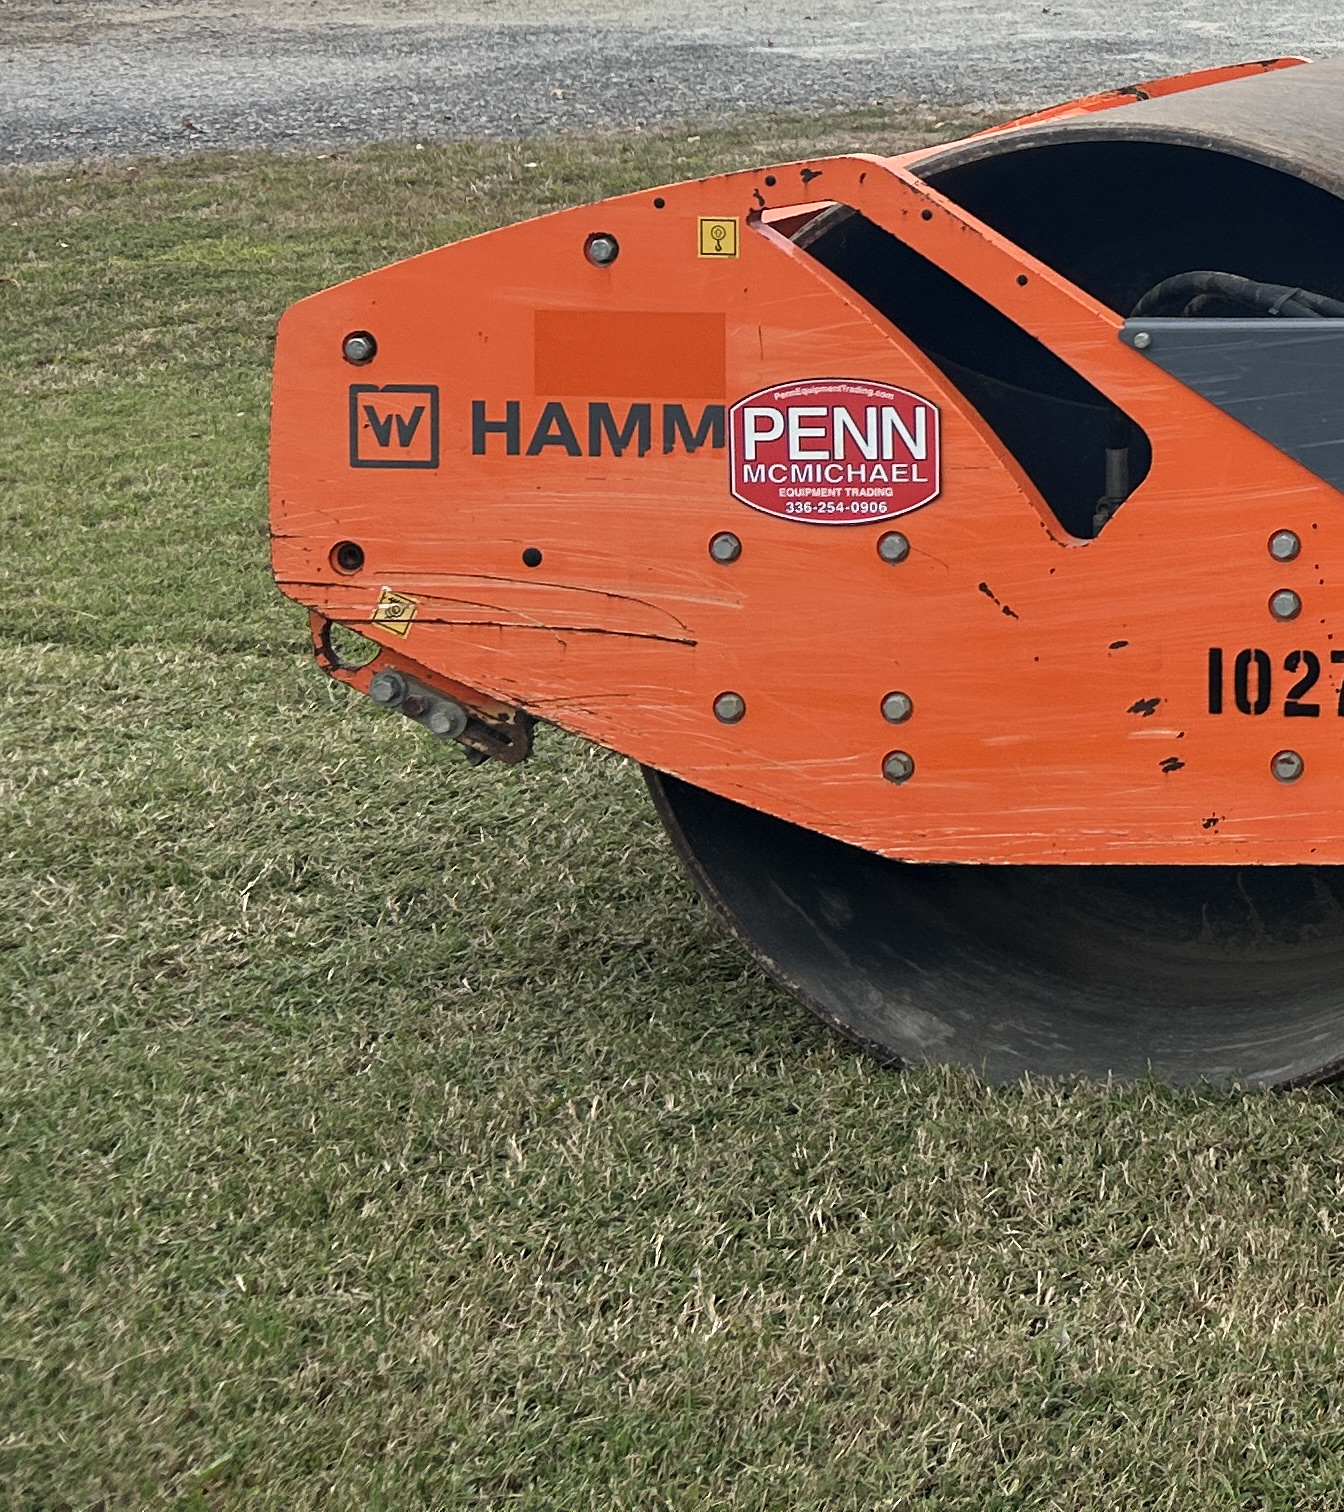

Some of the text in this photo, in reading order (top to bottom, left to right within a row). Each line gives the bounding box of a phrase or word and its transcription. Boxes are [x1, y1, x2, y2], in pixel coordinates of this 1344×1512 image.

[471, 400, 726, 458] HAMM
[743, 405, 927, 461] PENN
[743, 463, 929, 484] MCMICHAEL
[778, 488, 894, 498] EQUIPMENT TRADING
[785, 501, 888, 514] 336-254-0906
